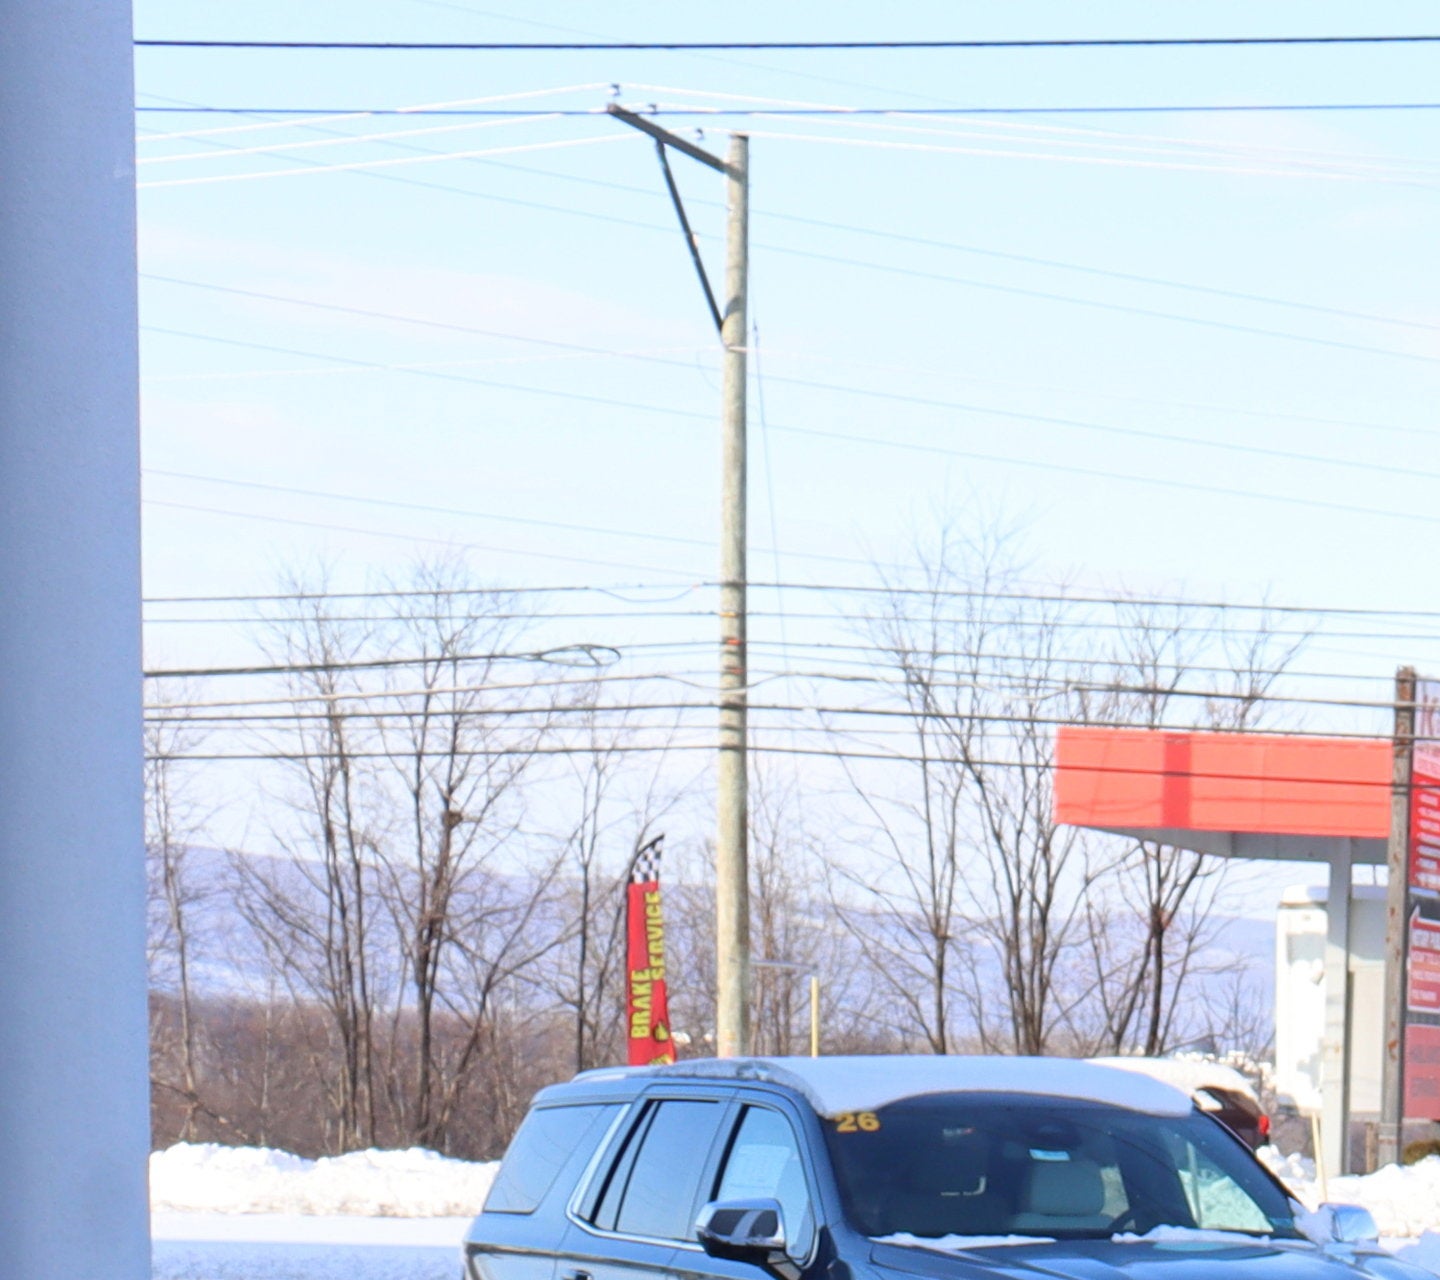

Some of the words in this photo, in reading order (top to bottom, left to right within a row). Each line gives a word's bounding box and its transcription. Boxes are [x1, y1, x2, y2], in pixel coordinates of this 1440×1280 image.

[645, 890, 665, 981] SERVICE
[630, 968, 651, 1039] BRAKE
[836, 1111, 881, 1134] 26
